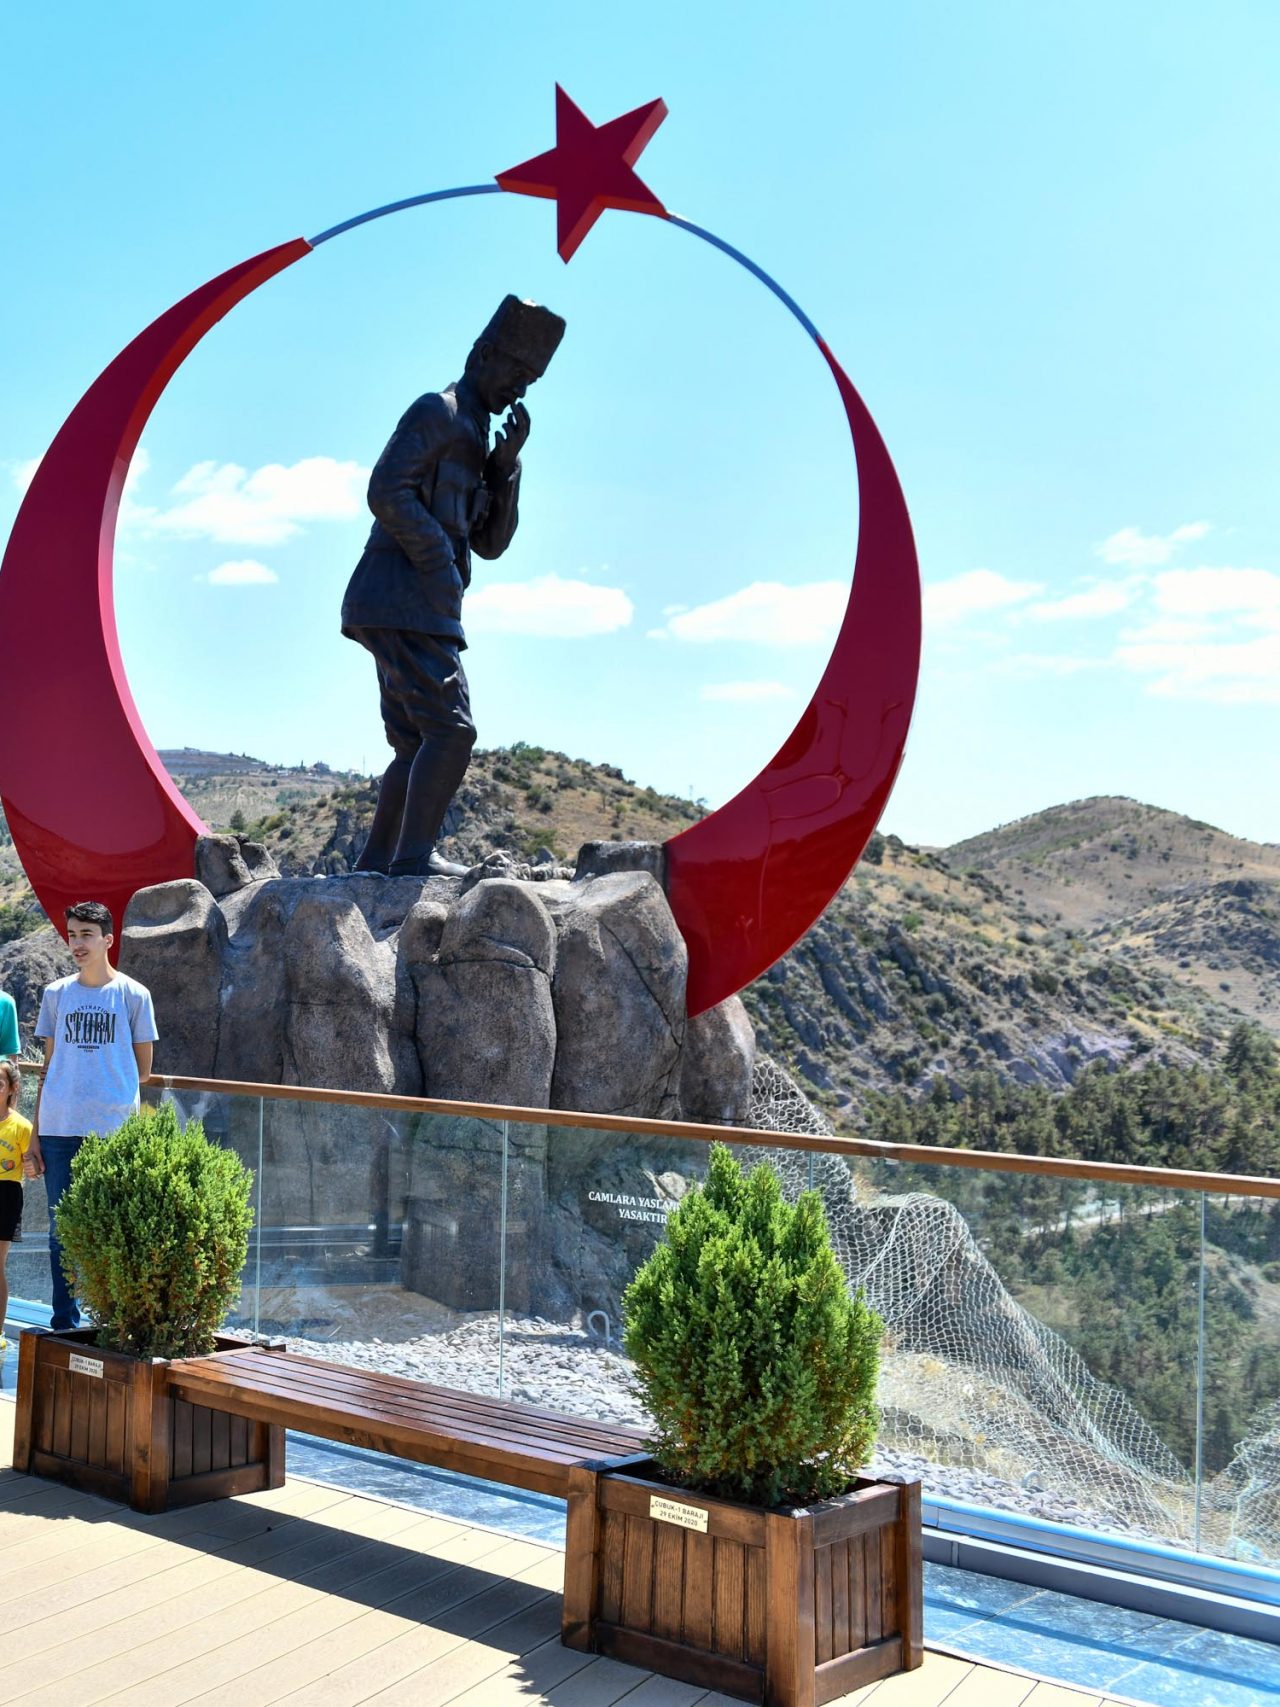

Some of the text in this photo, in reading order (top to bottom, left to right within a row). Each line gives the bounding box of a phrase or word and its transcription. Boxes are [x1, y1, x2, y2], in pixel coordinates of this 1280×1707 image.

[65, 1012, 117, 1044] STORM
[588, 1190, 636, 1206] CAMLARA
[618, 1208, 667, 1224] YASAKTIR
[682, 1508, 704, 1520] BARAJI
[684, 1517, 698, 1526] 2020
